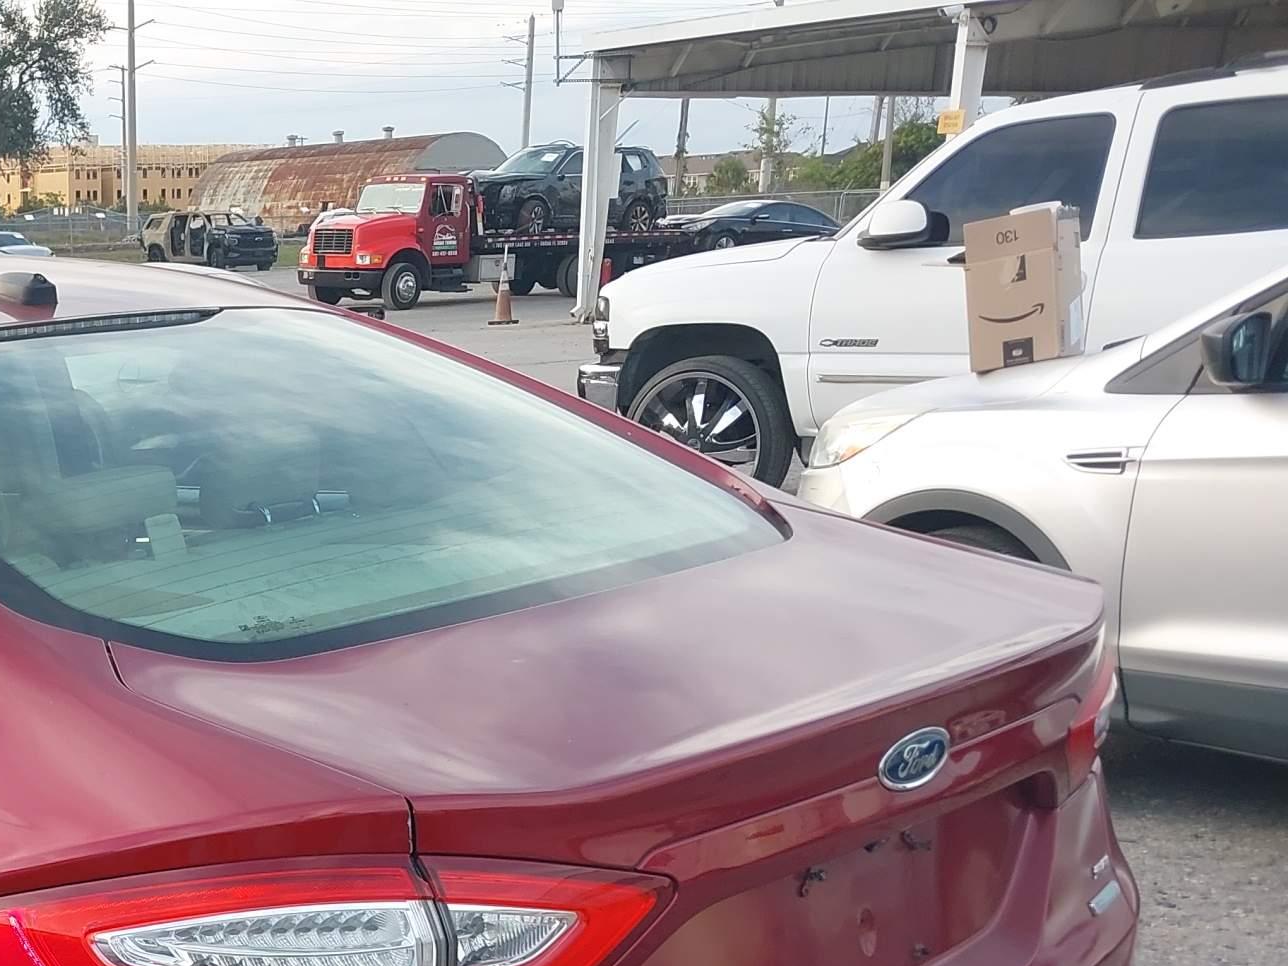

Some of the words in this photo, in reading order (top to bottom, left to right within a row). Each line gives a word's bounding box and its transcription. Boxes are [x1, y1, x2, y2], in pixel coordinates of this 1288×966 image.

[995, 229, 1020, 246] 130
[836, 338, 879, 348] TAHOE
[898, 740, 939, 779] Ford
